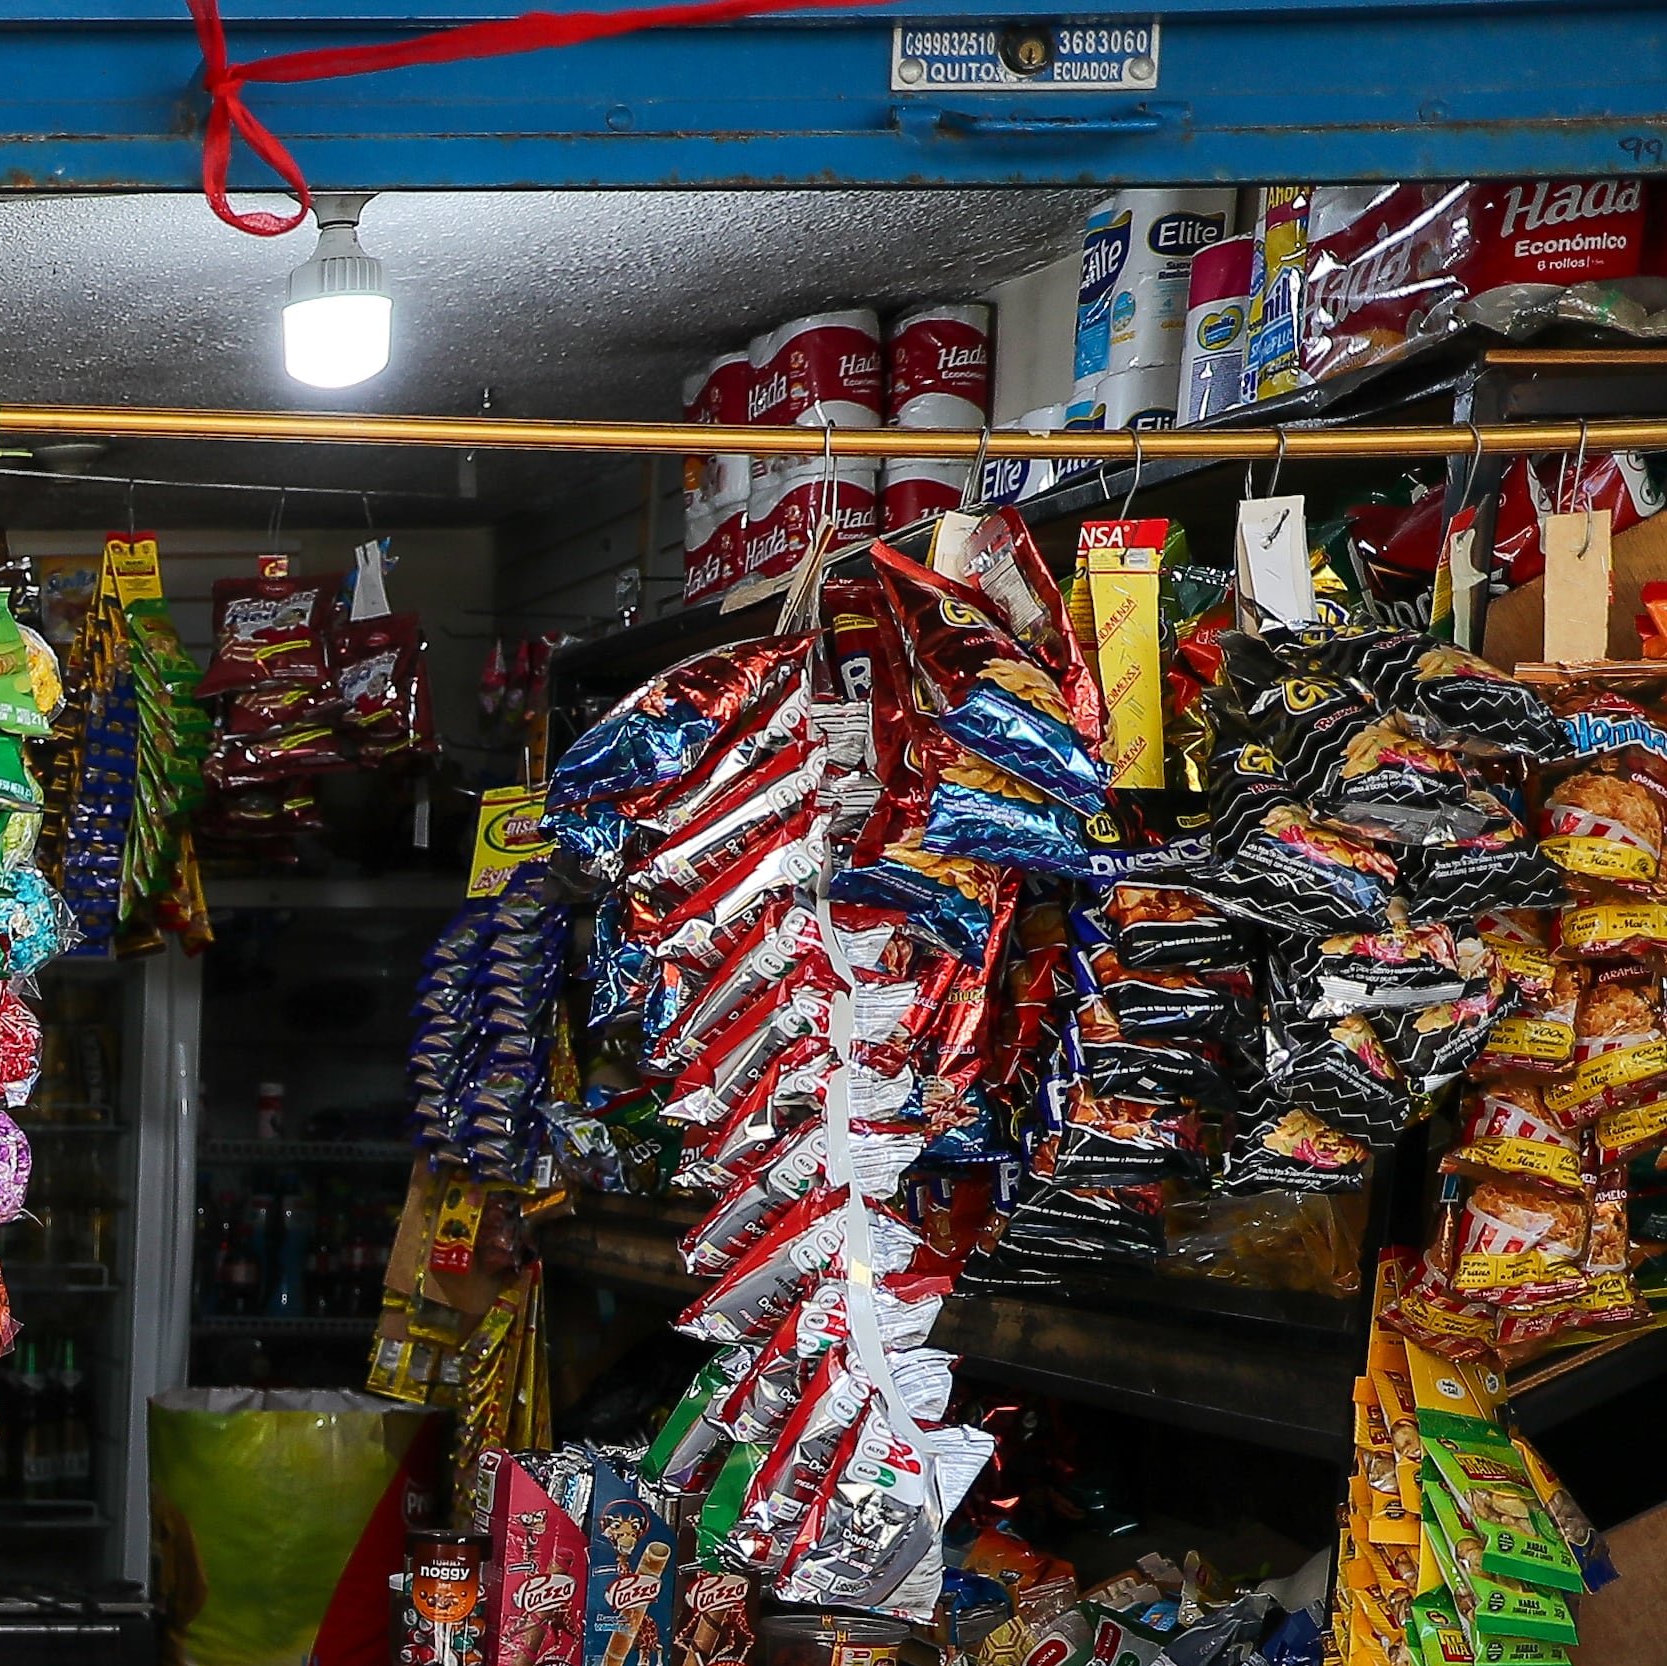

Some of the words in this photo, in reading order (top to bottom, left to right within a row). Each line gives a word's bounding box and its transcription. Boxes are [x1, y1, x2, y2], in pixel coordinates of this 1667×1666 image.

[1059, 30, 1148, 54] 3683060
[930, 62, 995, 81] QUITO
[1053, 61, 1118, 81] ECUADOR
[1500, 182, 1643, 238] Hada
[1158, 221, 1220, 247] Elite
[1513, 234, 1628, 258] Económico
[747, 372, 788, 421] Hada
[419, 1564, 470, 1582] noggy
